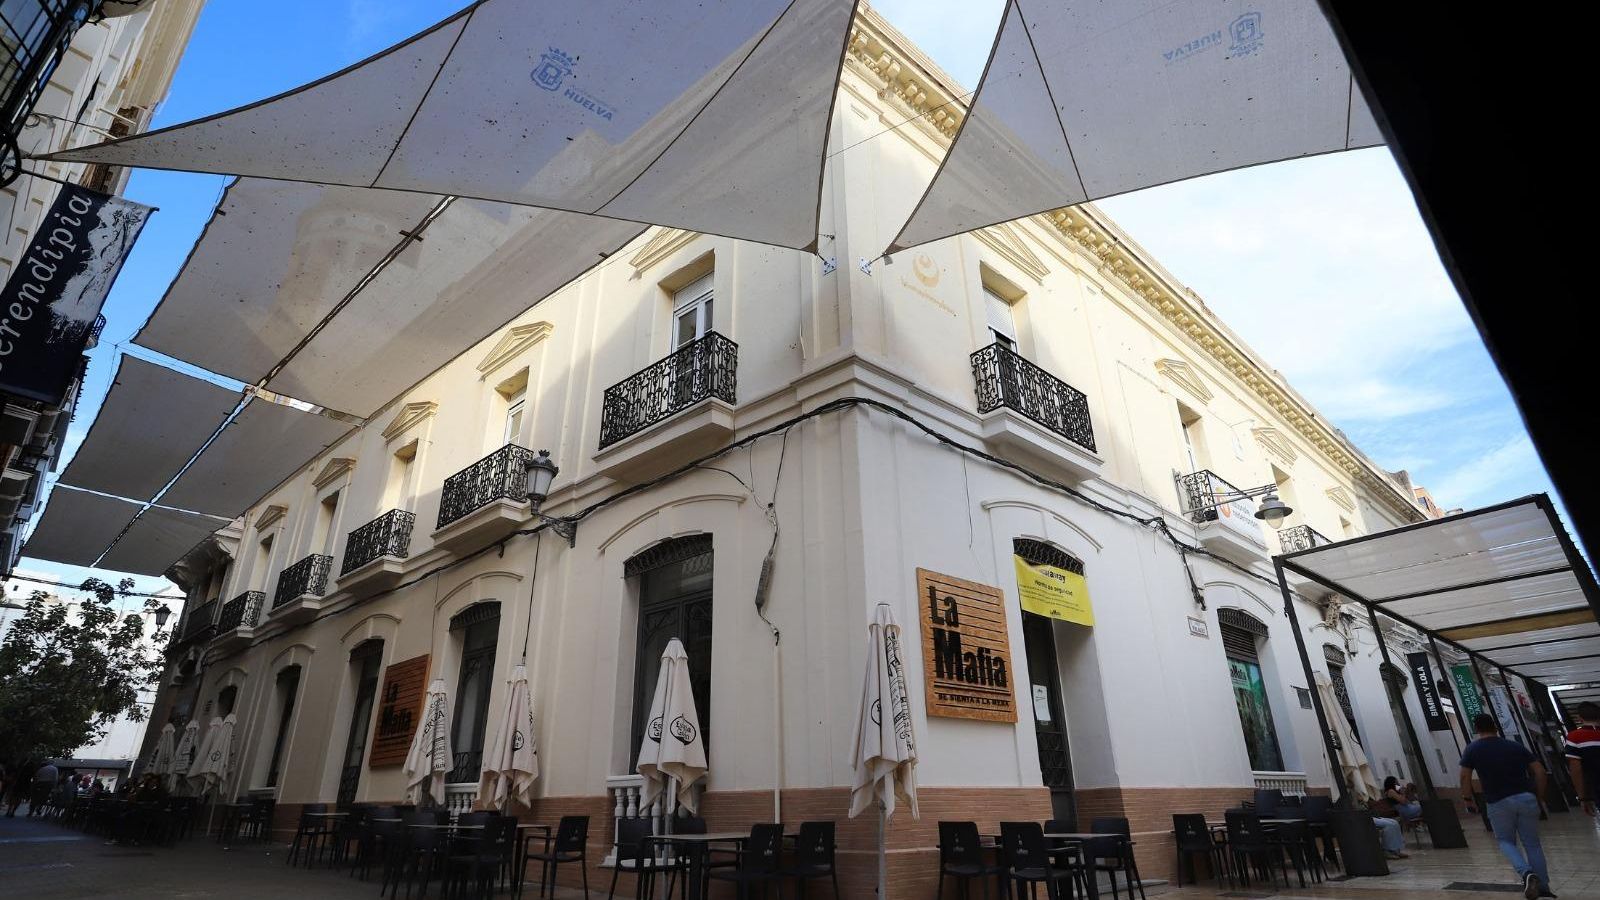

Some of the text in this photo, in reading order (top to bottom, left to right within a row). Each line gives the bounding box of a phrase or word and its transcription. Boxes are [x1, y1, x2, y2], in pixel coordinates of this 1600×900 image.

[1163, 31, 1221, 60] HUELVA
[564, 89, 613, 120] HUELVA
[0, 194, 92, 371] erendipia
[929, 585, 959, 627] La
[934, 628, 1007, 687] Mafia
[1417, 666, 1428, 685] LOLA
[381, 704, 412, 737] Mafia
[1425, 692, 1439, 717] BIMBA
